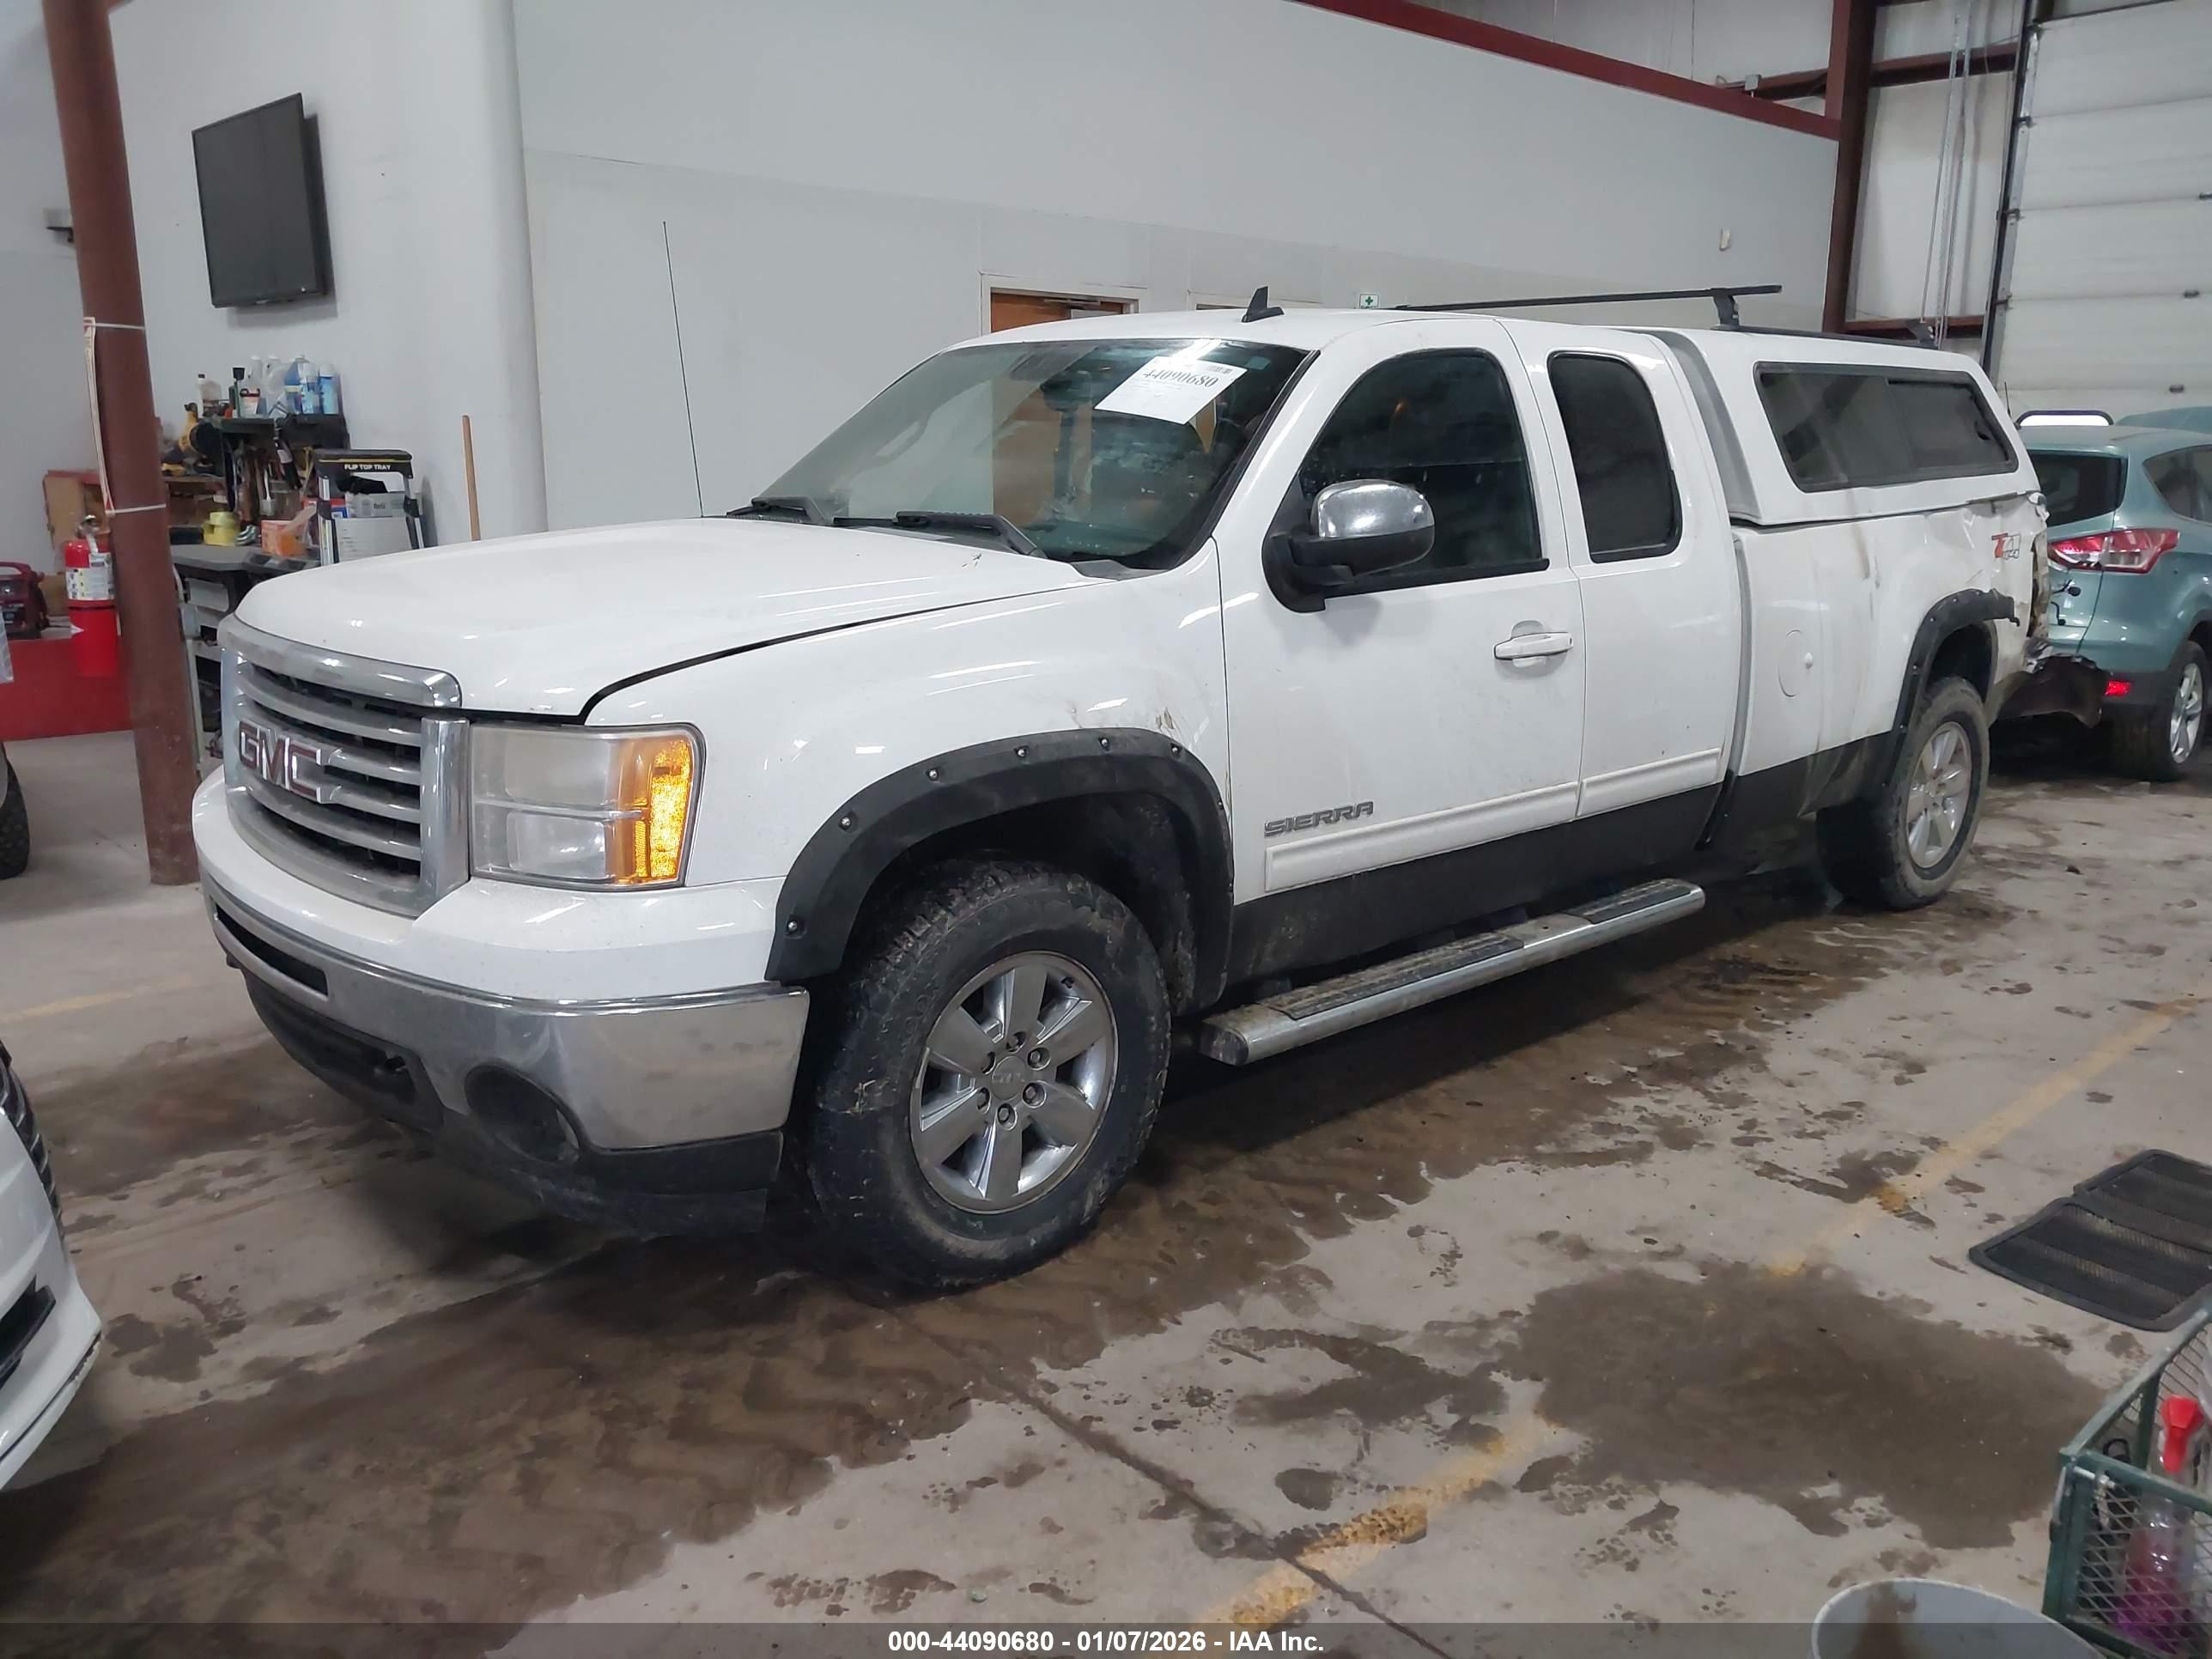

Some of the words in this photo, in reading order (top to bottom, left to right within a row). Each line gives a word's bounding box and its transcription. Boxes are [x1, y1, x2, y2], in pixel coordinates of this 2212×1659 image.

[1143, 368, 1218, 388] 44090680
[239, 719, 322, 804] GMC
[1264, 800, 1374, 837] SIERRA
